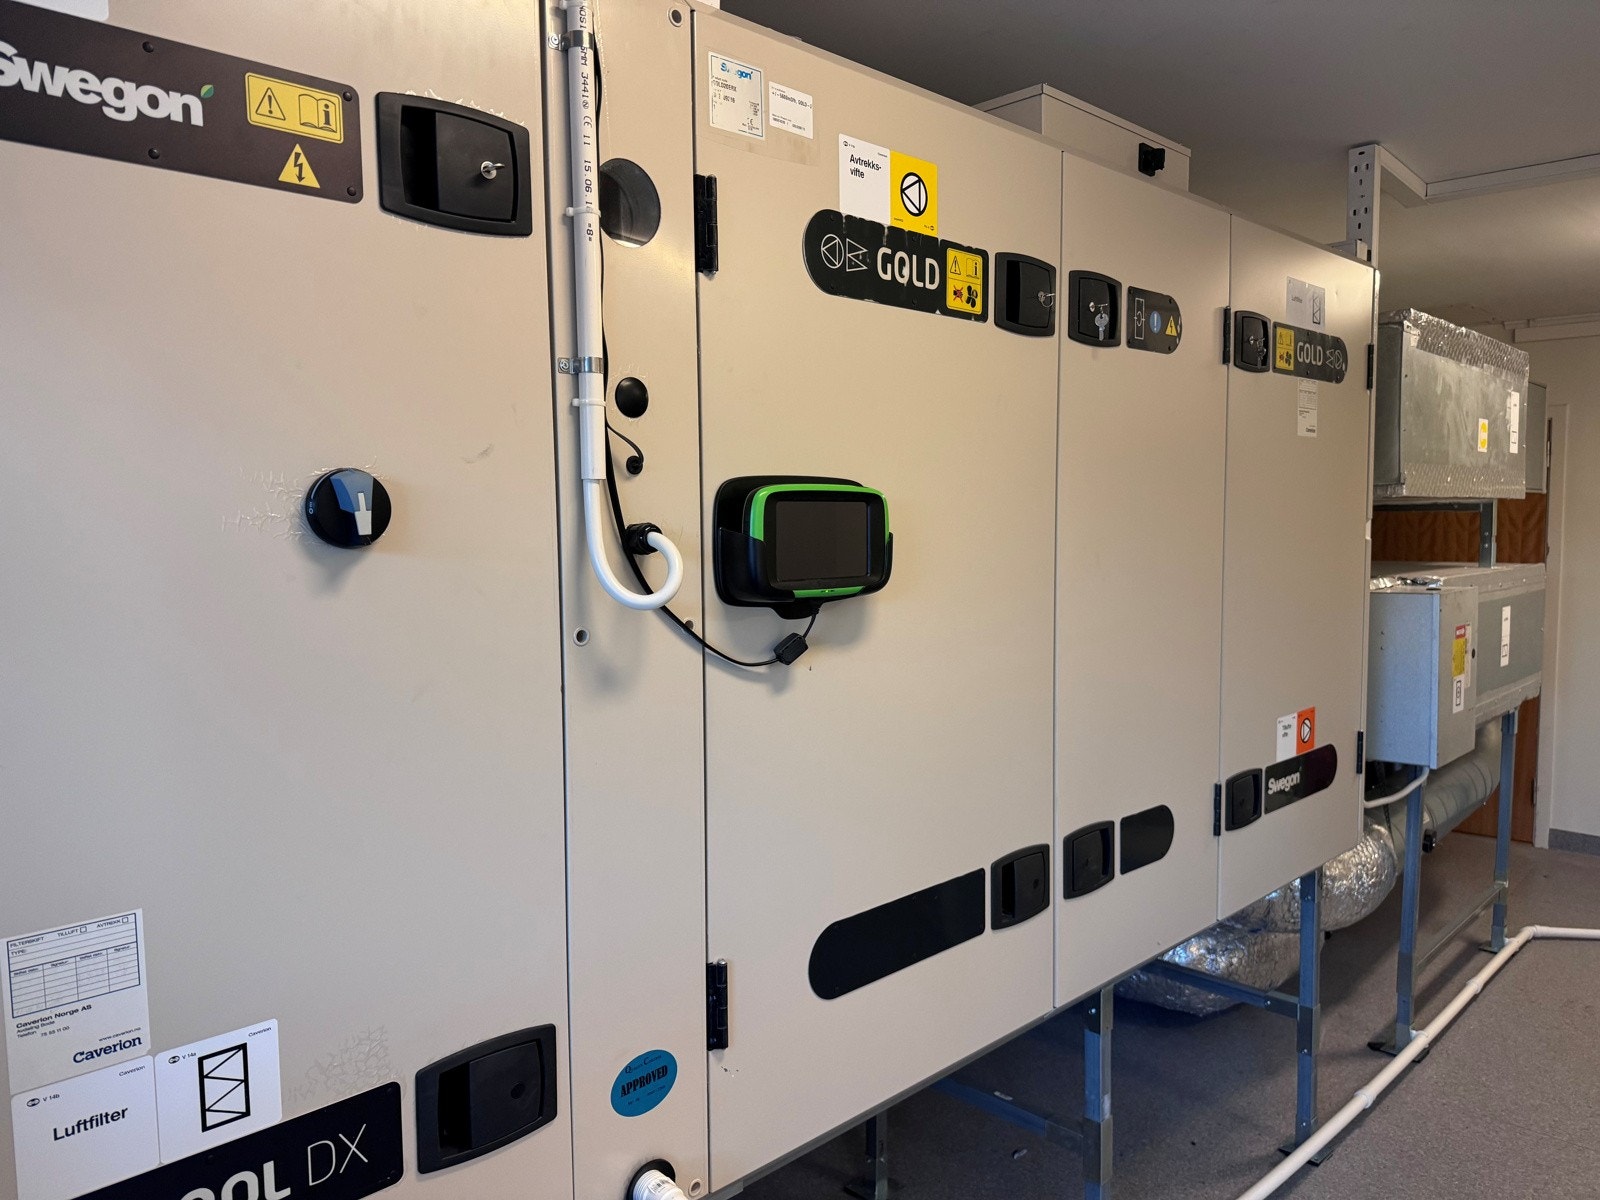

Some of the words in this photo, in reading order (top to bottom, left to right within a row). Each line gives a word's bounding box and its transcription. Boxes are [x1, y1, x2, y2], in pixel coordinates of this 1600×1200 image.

[0, 40, 204, 127] Swegon
[581, 72, 589, 98] 3441
[849, 154, 882, 171] Avtrekks-
[849, 167, 865, 178] vifte
[877, 246, 940, 290] GOLD
[1297, 341, 1323, 366] GOLD
[1267, 771, 1300, 795] Swegon
[10, 936, 44, 948] FILTERSKIFT
[57, 928, 79, 937] TILLUFT
[96, 920, 121, 928] AVTREKK
[16, 1015, 52, 1029] Caverion
[54, 1007, 80, 1018] Norge
[98, 1027, 142, 1041] www.caverion.no
[247, 1026, 272, 1037] Caverion
[73, 1036, 143, 1064] Caverion
[118, 1065, 146, 1077] Caverion
[620, 1064, 668, 1098] APPROVED
[53, 1107, 129, 1141] Luftfilter
[307, 1123, 368, 1186] DX
